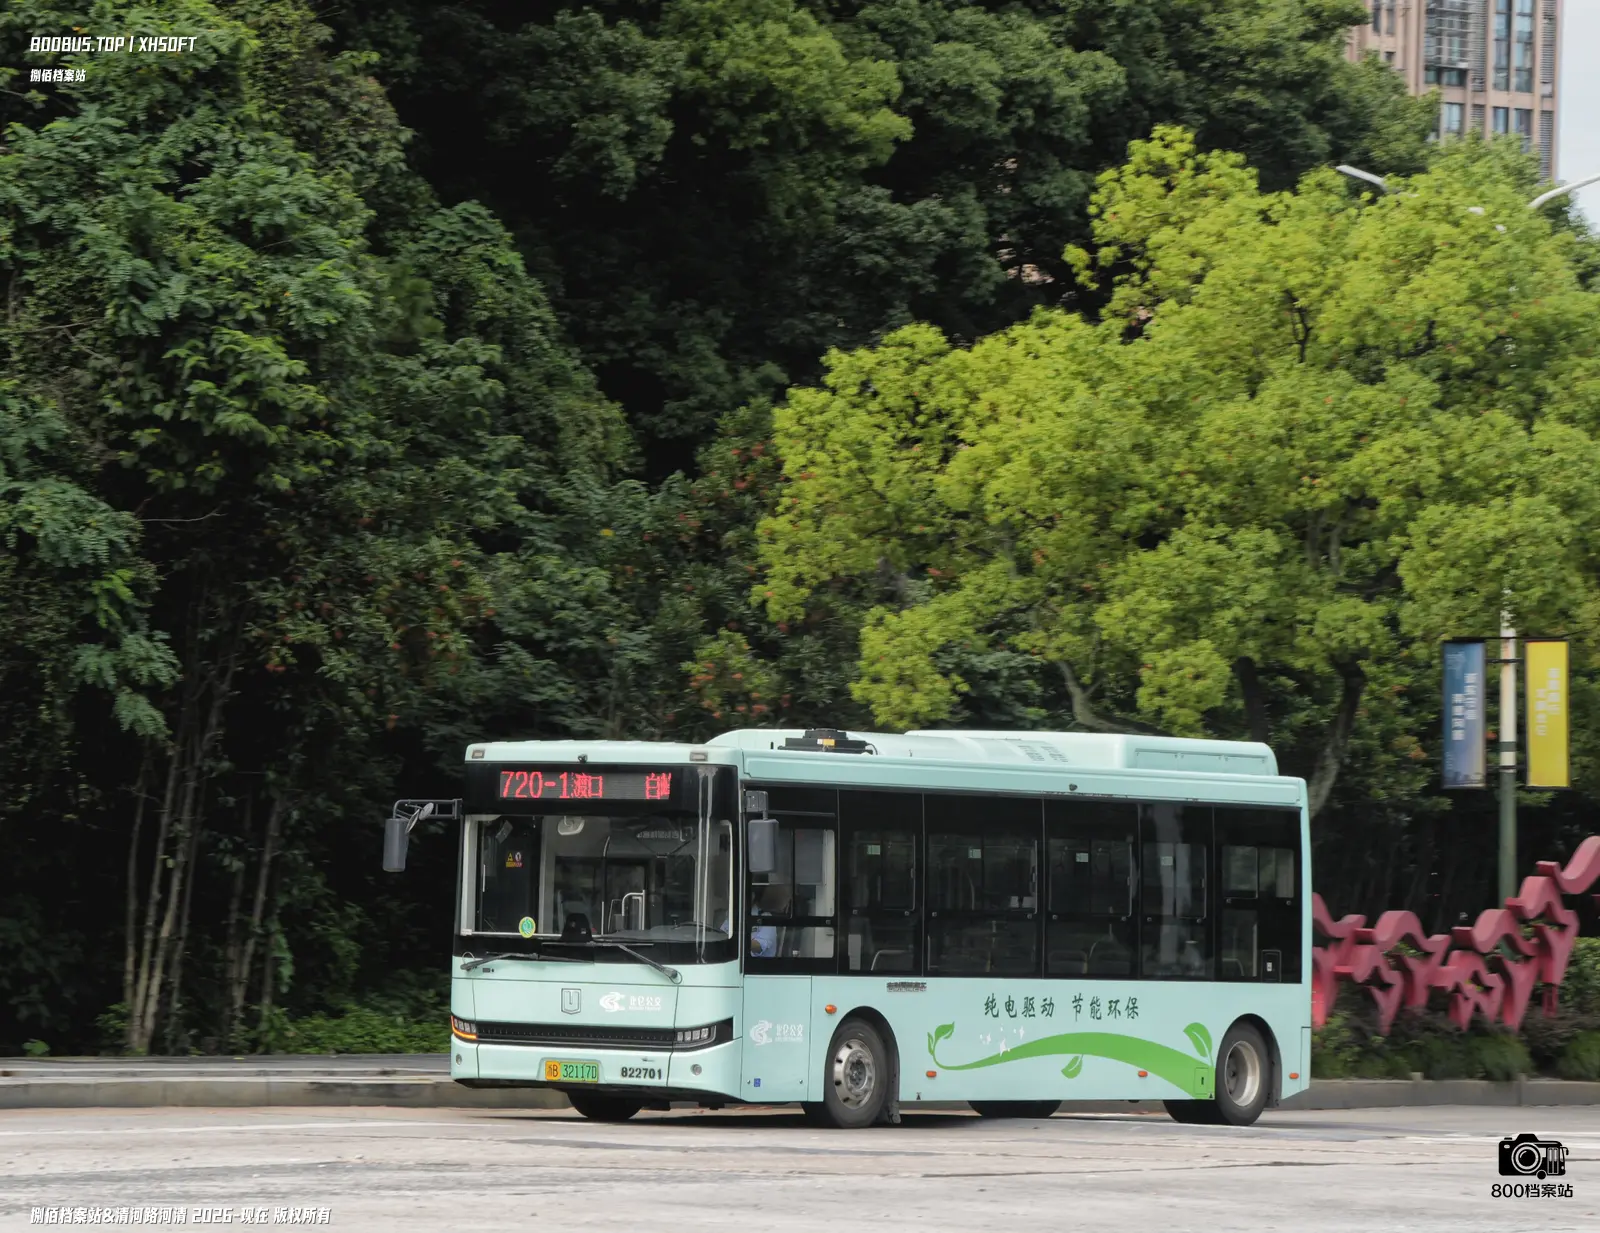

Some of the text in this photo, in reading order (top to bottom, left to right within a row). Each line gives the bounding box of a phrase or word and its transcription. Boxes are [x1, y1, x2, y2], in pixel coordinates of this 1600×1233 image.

[984, 992, 1139, 1022] 纯电驱动 节能环保
[621, 1066, 662, 1080] 822701
